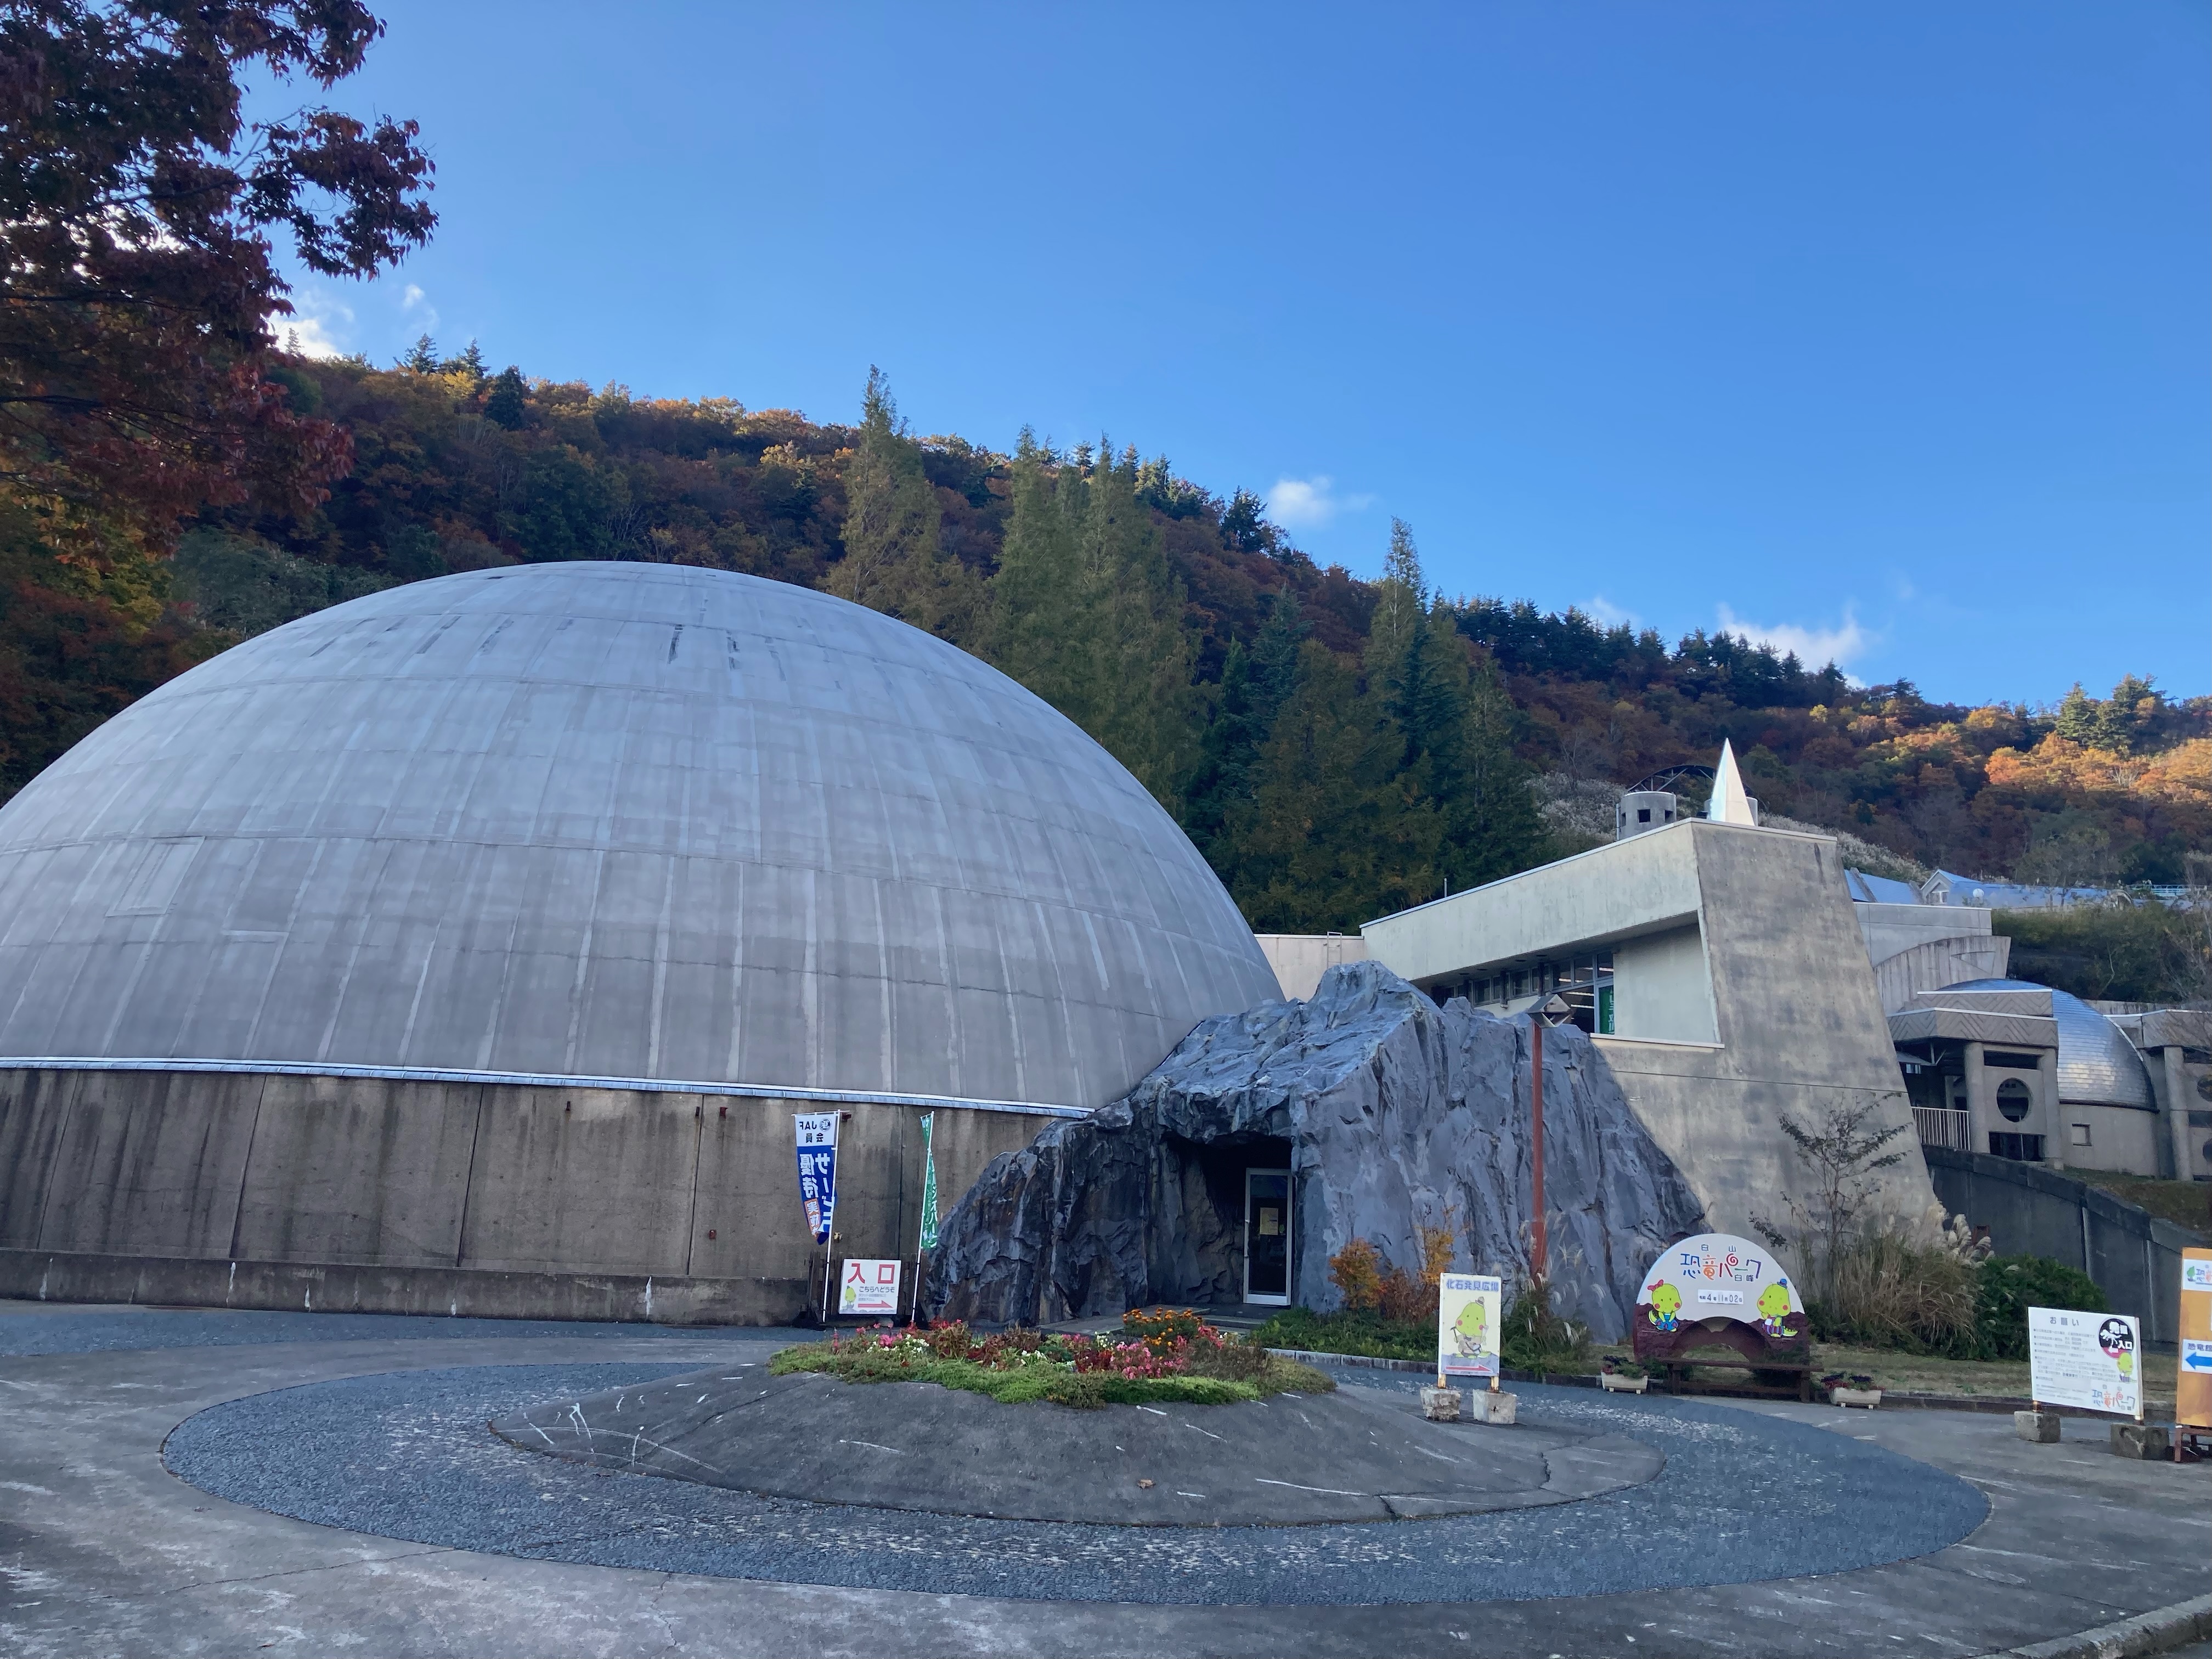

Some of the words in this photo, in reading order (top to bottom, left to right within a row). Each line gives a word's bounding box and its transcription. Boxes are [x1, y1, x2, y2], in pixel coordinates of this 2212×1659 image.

[848, 1263, 895, 1284] 入口
[1447, 1279, 1499, 1291] 化石発見広場
[2118, 1340, 2133, 1350] 入口
